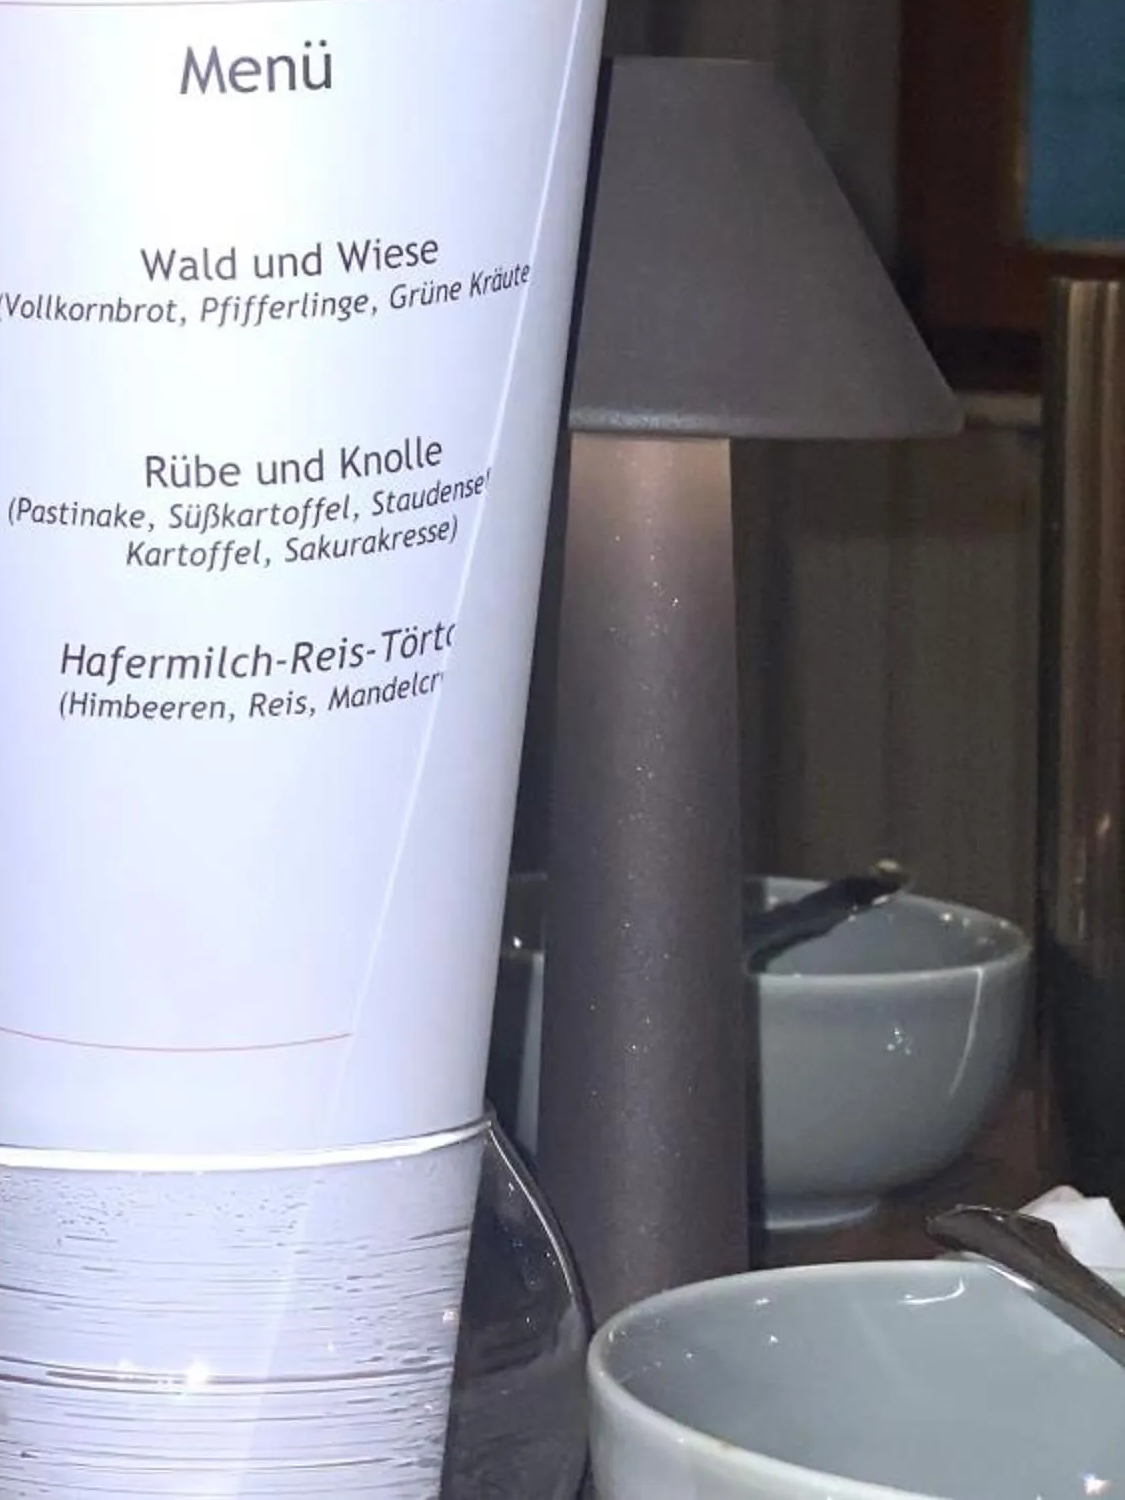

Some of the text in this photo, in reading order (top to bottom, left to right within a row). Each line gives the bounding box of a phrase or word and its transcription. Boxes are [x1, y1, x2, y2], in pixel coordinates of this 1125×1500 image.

[179, 38, 333, 95] Menü
[139, 237, 439, 282] Wald und Wiese
[199, 290, 378, 328] Pfifferlinge,
[389, 280, 462, 310] Grüne
[145, 435, 443, 489] Rübe und Knolle
[8, 496, 155, 533] (Pastinake,
[168, 492, 360, 535] Süßkartoffel,
[126, 514, 458, 573] Kartoffel, Sakurakresse)
[58, 671, 444, 724] (Himbeeren, Reis, Mandelcr
